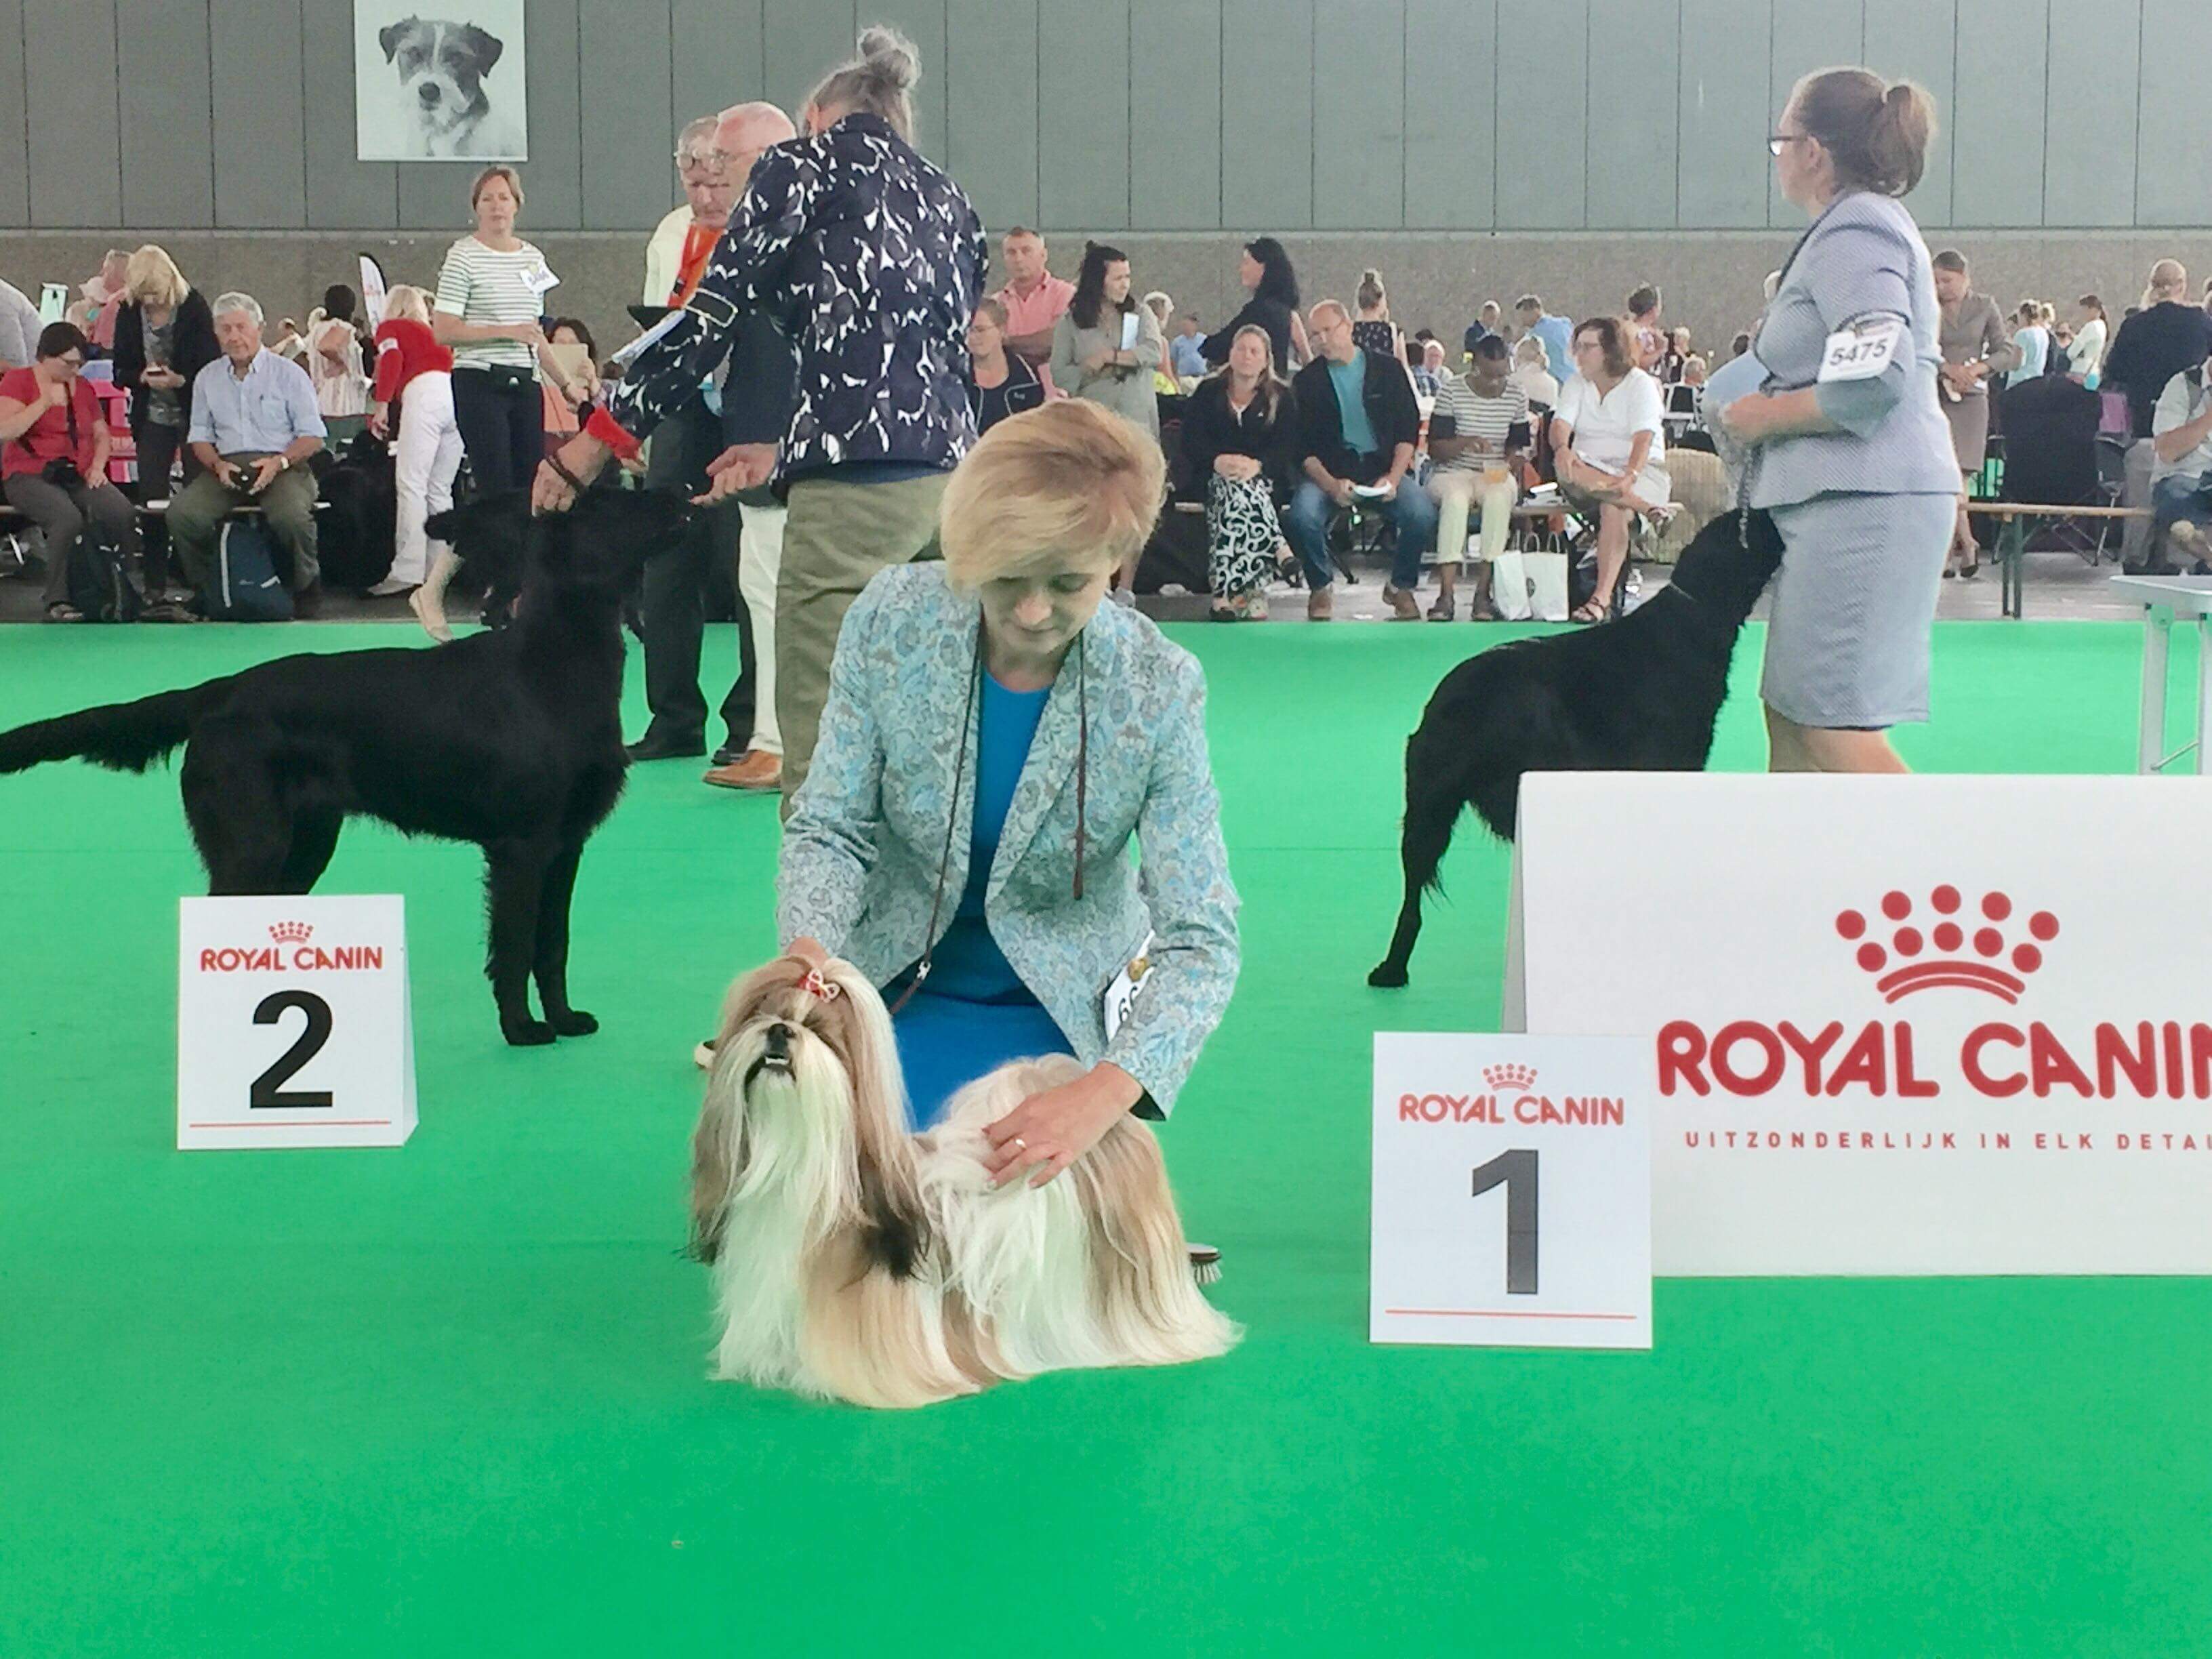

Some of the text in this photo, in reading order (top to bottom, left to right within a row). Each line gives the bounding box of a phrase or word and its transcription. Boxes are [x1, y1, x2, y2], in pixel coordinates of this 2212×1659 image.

[1829, 337, 1888, 367] 5475
[199, 946, 384, 972] ROYAL CANIN
[249, 989, 333, 1109] 2
[1655, 1019, 1940, 1099] ROYAL
[1398, 1093, 1624, 1126] ROYAL CANIN
[1685, 1131, 1957, 1149] UITZONDERLIJK
[1980, 1132, 2011, 1149] IN
[2034, 1133, 2093, 1150] ELK
[1472, 1149, 1539, 1295] 1
